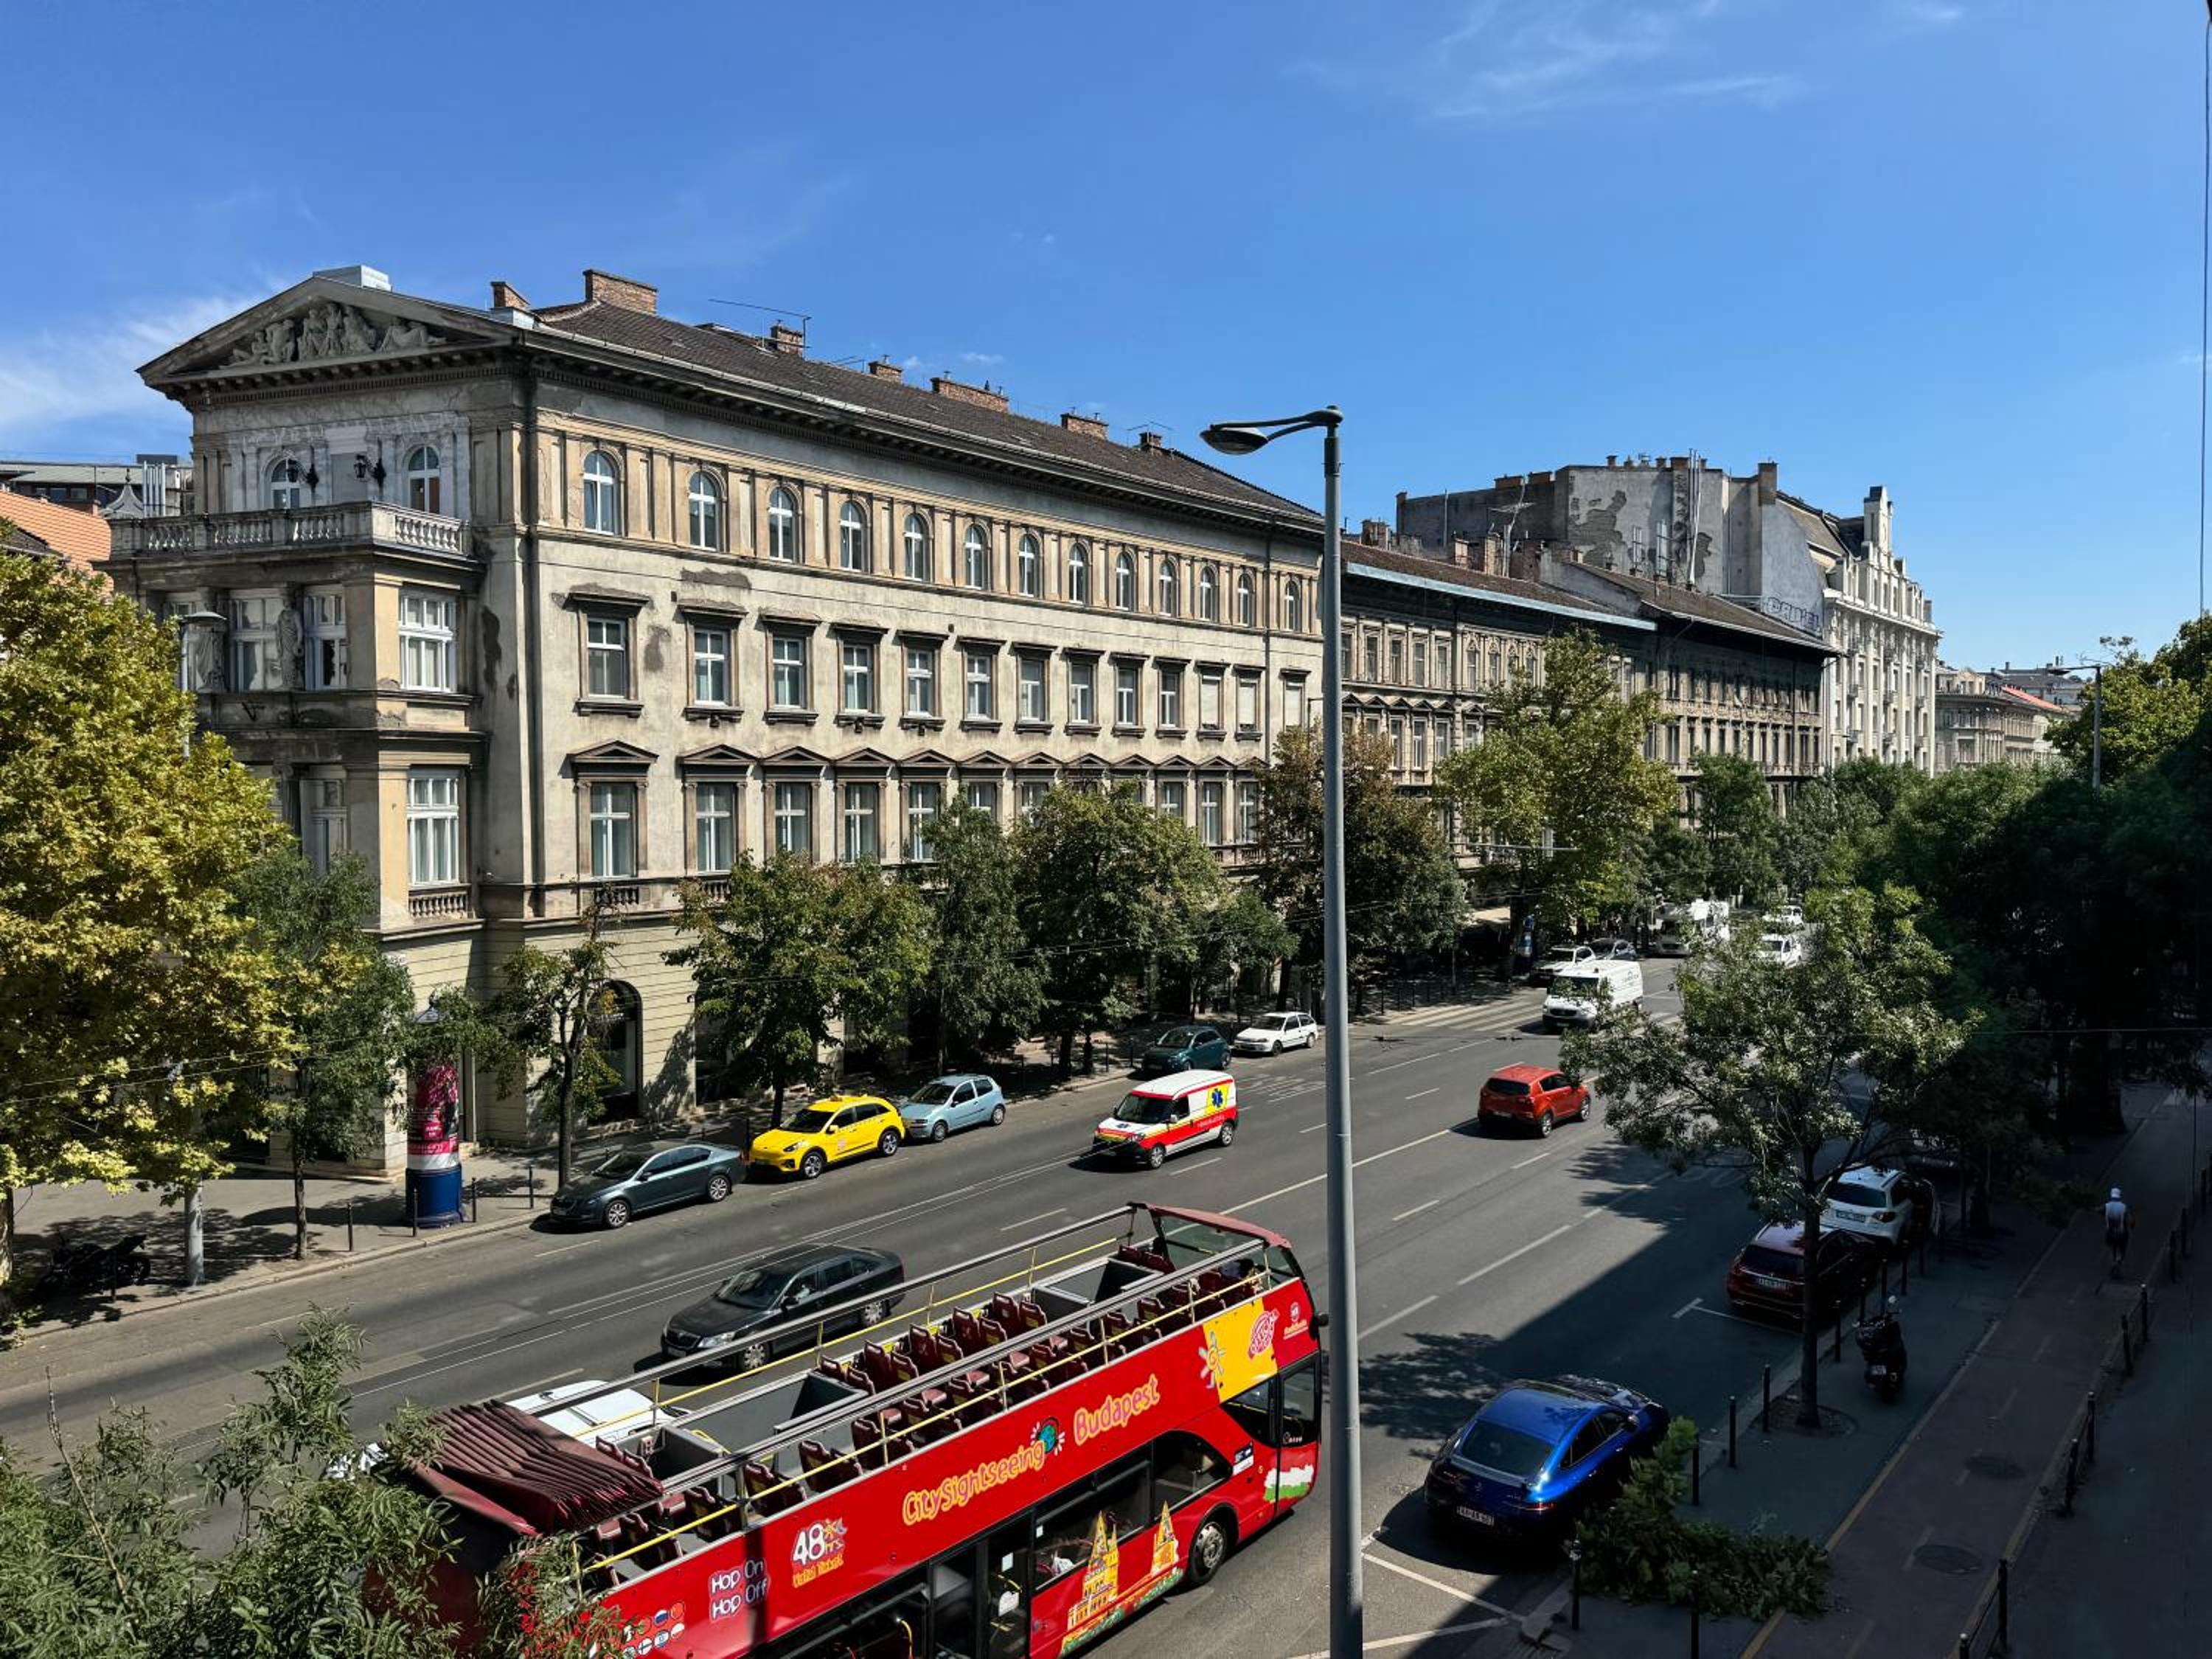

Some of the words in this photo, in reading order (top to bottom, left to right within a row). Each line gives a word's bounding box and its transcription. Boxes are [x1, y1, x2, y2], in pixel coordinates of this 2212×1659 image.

[1074, 1374, 1161, 1447] Budapest
[793, 1522, 826, 1566] 48
[712, 1569, 741, 1594] Hop
[744, 1559, 764, 1579] On
[712, 1594, 742, 1619] Hop
[745, 1577, 768, 1604] Off
